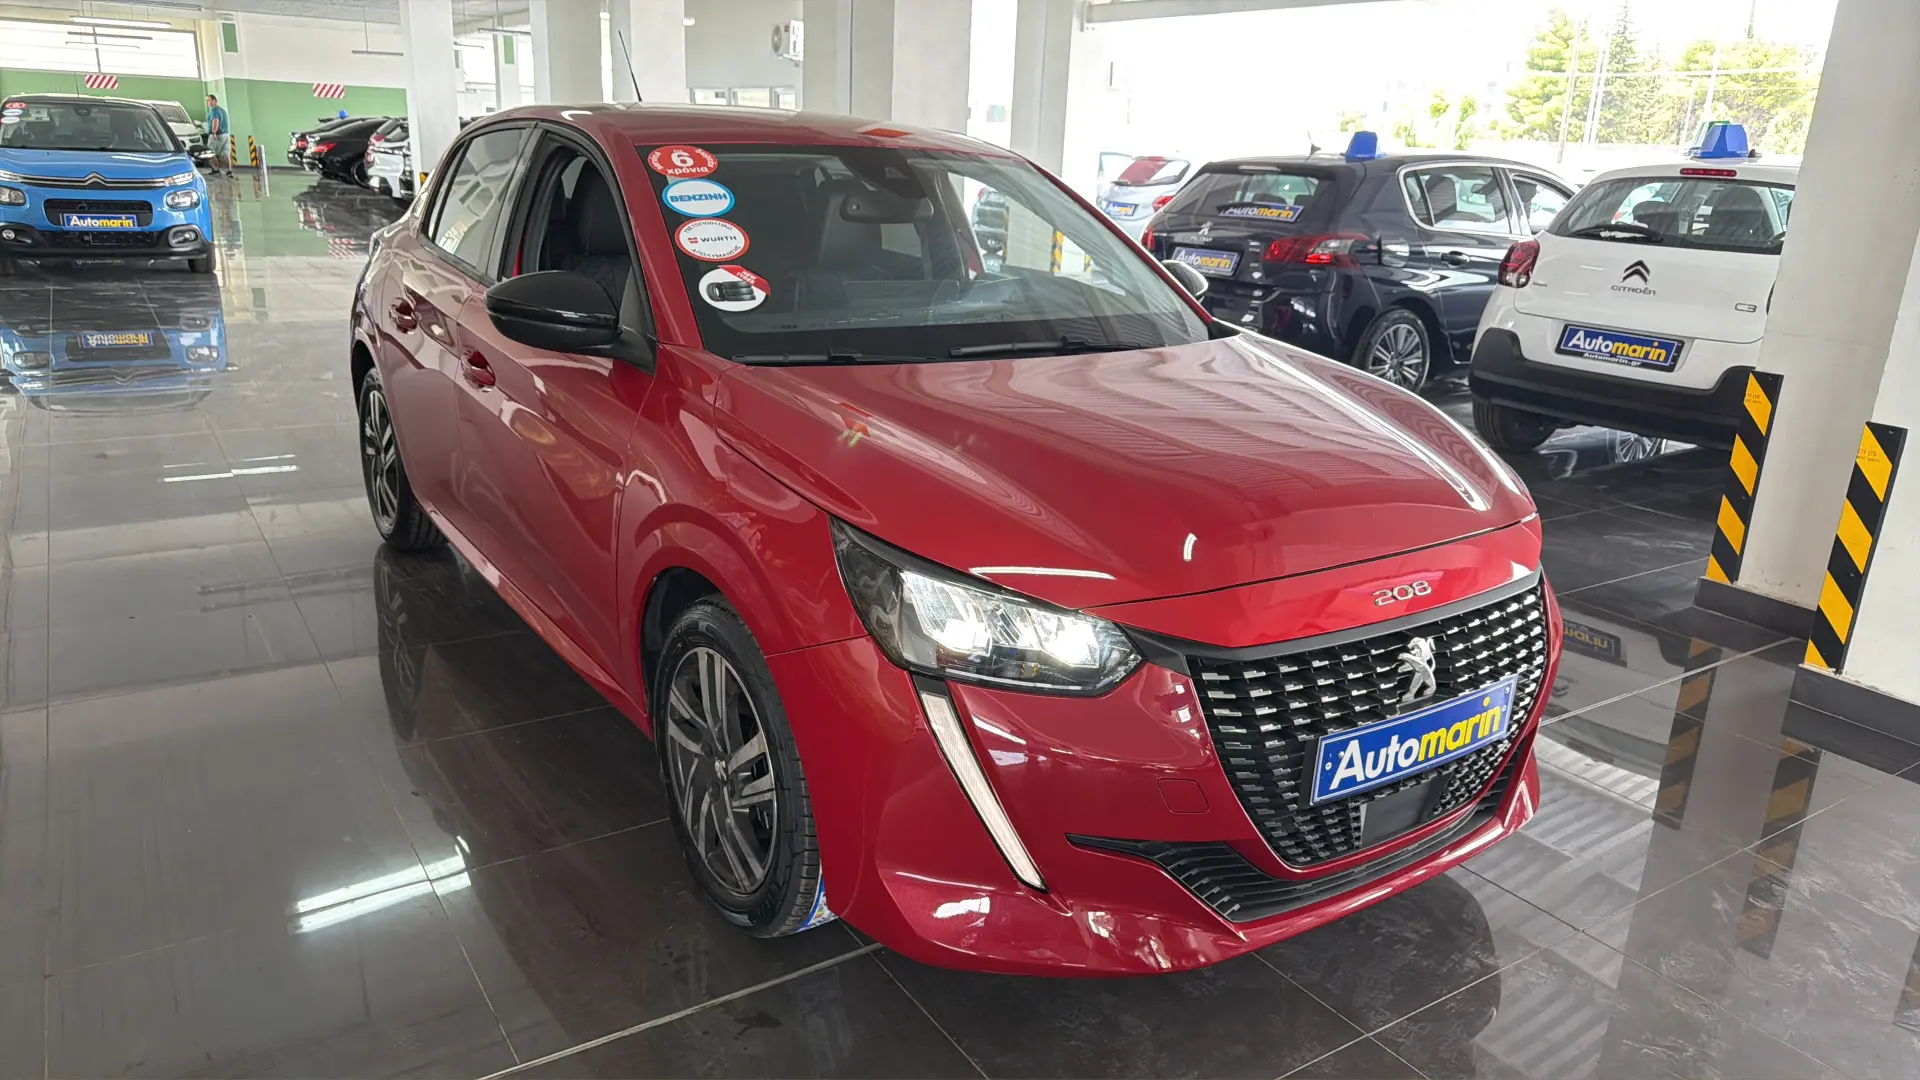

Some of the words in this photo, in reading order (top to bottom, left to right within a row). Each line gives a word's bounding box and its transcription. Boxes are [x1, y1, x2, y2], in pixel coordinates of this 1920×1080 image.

[671, 151, 694, 167] 6
[667, 166, 709, 175] χρόνια
[70, 215, 134, 228] Automarin
[1176, 249, 1231, 268] Automarin
[1735, 302, 1757, 313] C3
[1568, 330, 1666, 362] Automarin
[1372, 581, 1432, 606] 208
[1329, 696, 1501, 790] Automarin
